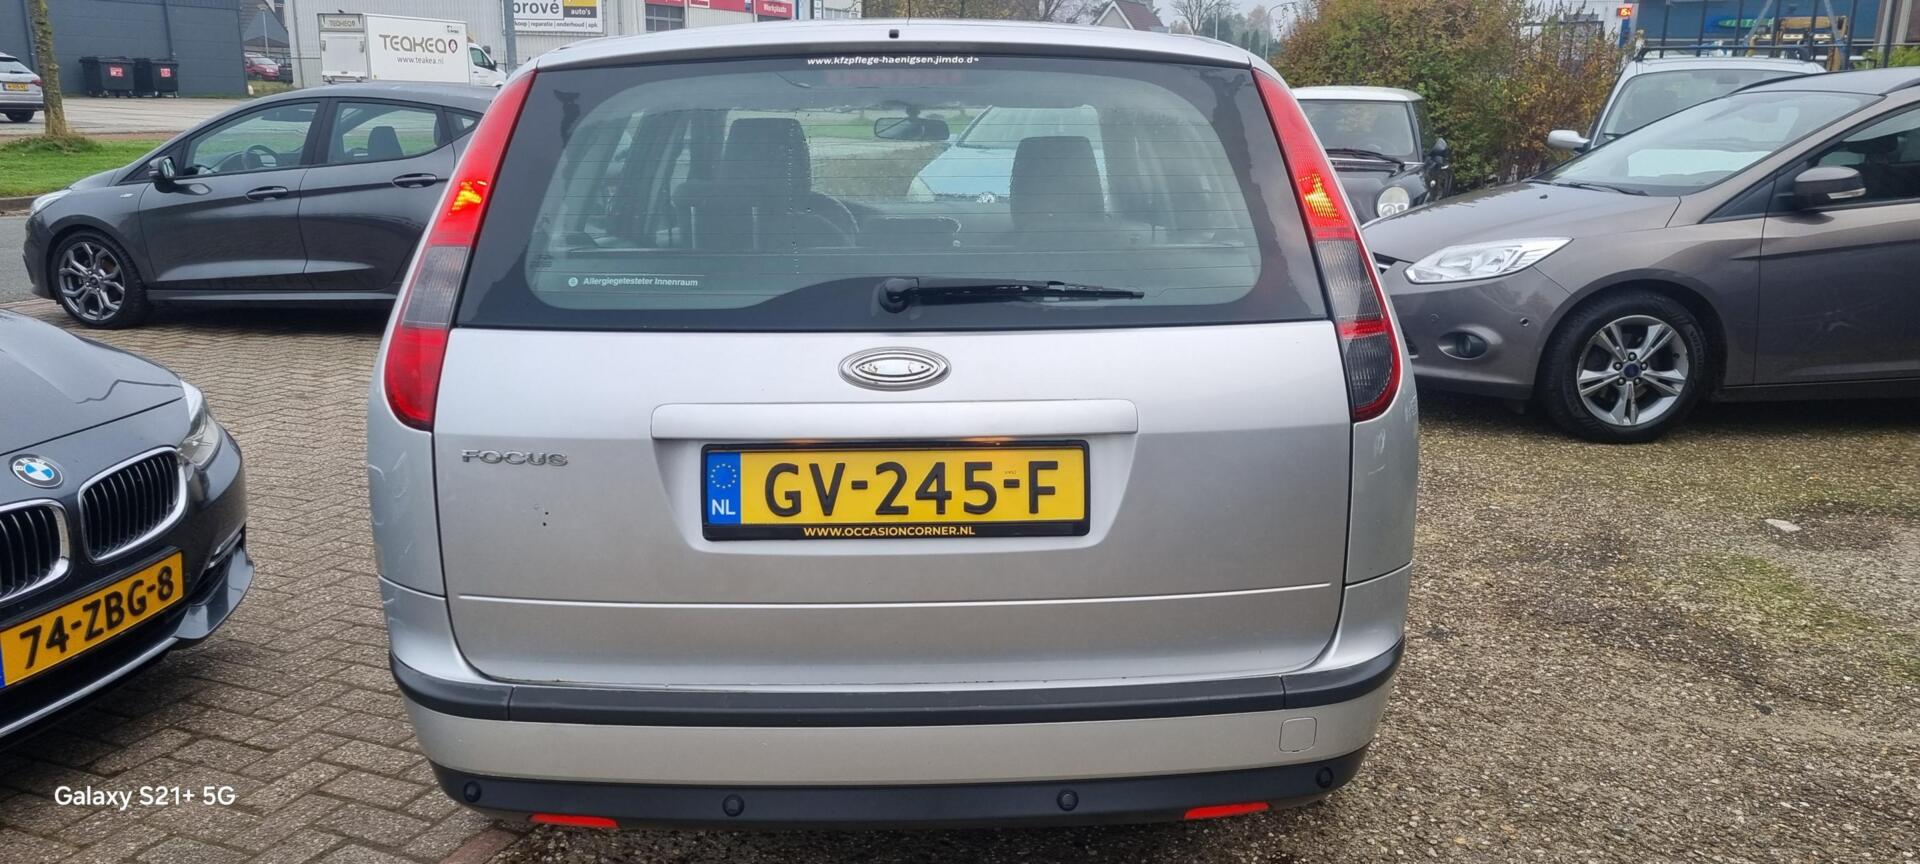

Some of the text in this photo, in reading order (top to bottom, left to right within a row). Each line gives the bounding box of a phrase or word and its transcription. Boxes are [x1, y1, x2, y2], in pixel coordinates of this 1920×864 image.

[396, 56, 444, 64] www.teakea.nl
[583, 277, 698, 287] Allergiegetesteter Innenraum
[461, 449, 569, 467] FOCUS
[763, 460, 1059, 518] GV-245-F
[711, 499, 736, 516] NL
[803, 526, 976, 537] WWW.OCCASIONCORNER.NL
[19, 565, 175, 670] 74-ZBG-8
